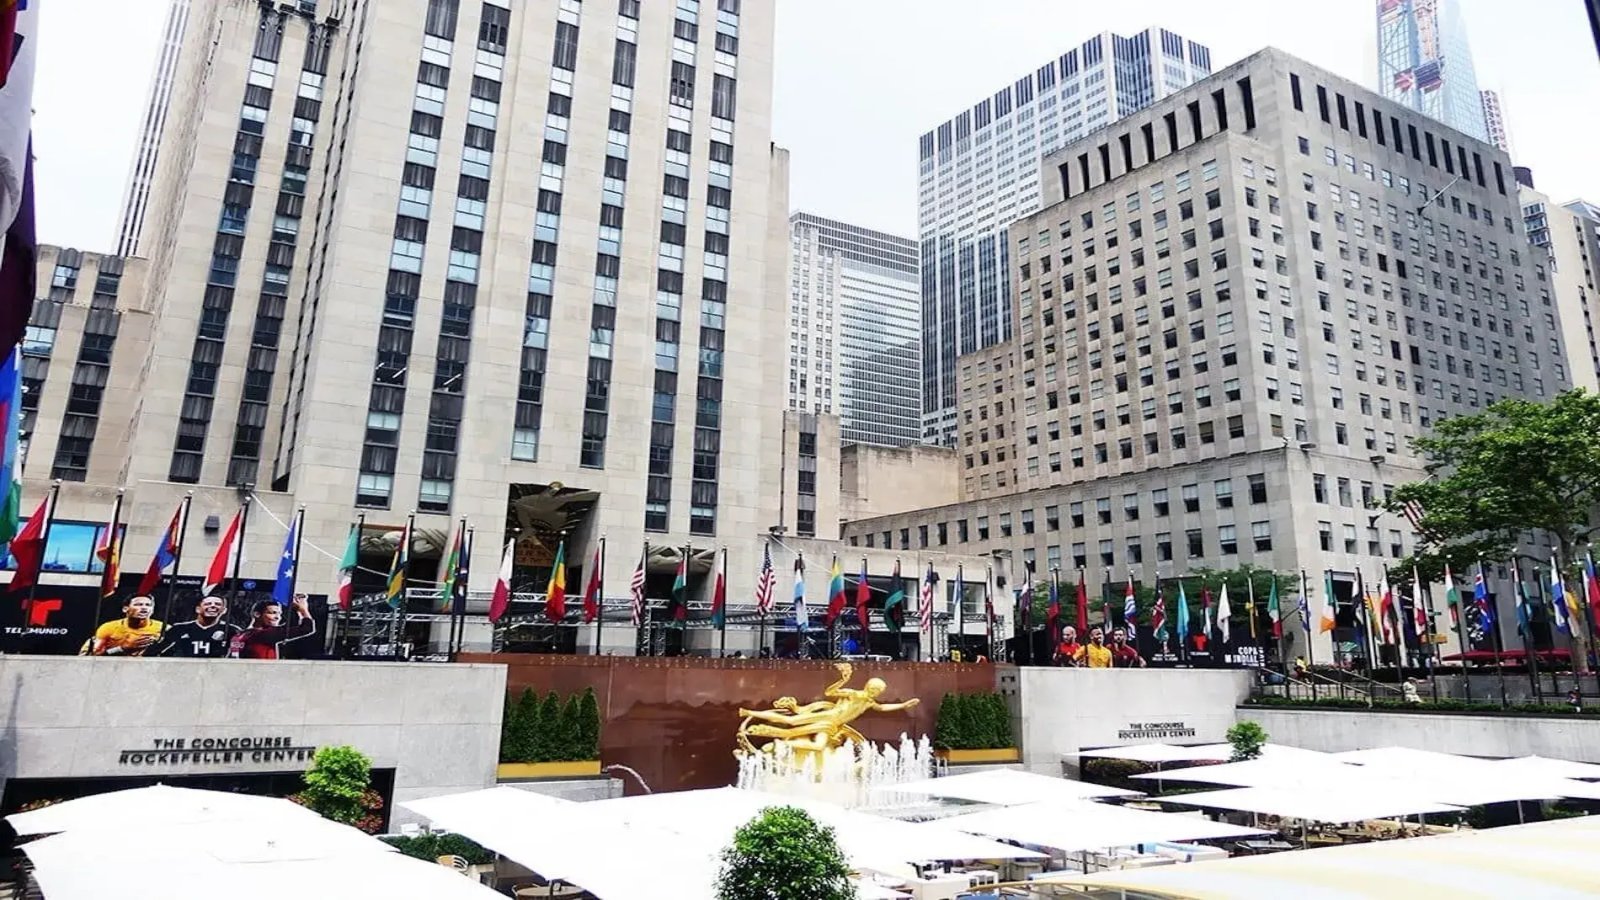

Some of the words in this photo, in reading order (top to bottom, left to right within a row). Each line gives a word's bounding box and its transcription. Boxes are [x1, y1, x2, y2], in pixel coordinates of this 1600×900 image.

[192, 641, 210, 655] 14
[1144, 722, 1184, 730] CONCOURSE
[1118, 730, 1167, 739] ROCKEFELLER
[1169, 729, 1195, 737] CENTER
[153, 738, 186, 749] THE
[191, 737, 292, 749] CONCOURSE
[118, 751, 243, 765] ROCKEFELLER
[252, 749, 315, 763] CENTER
